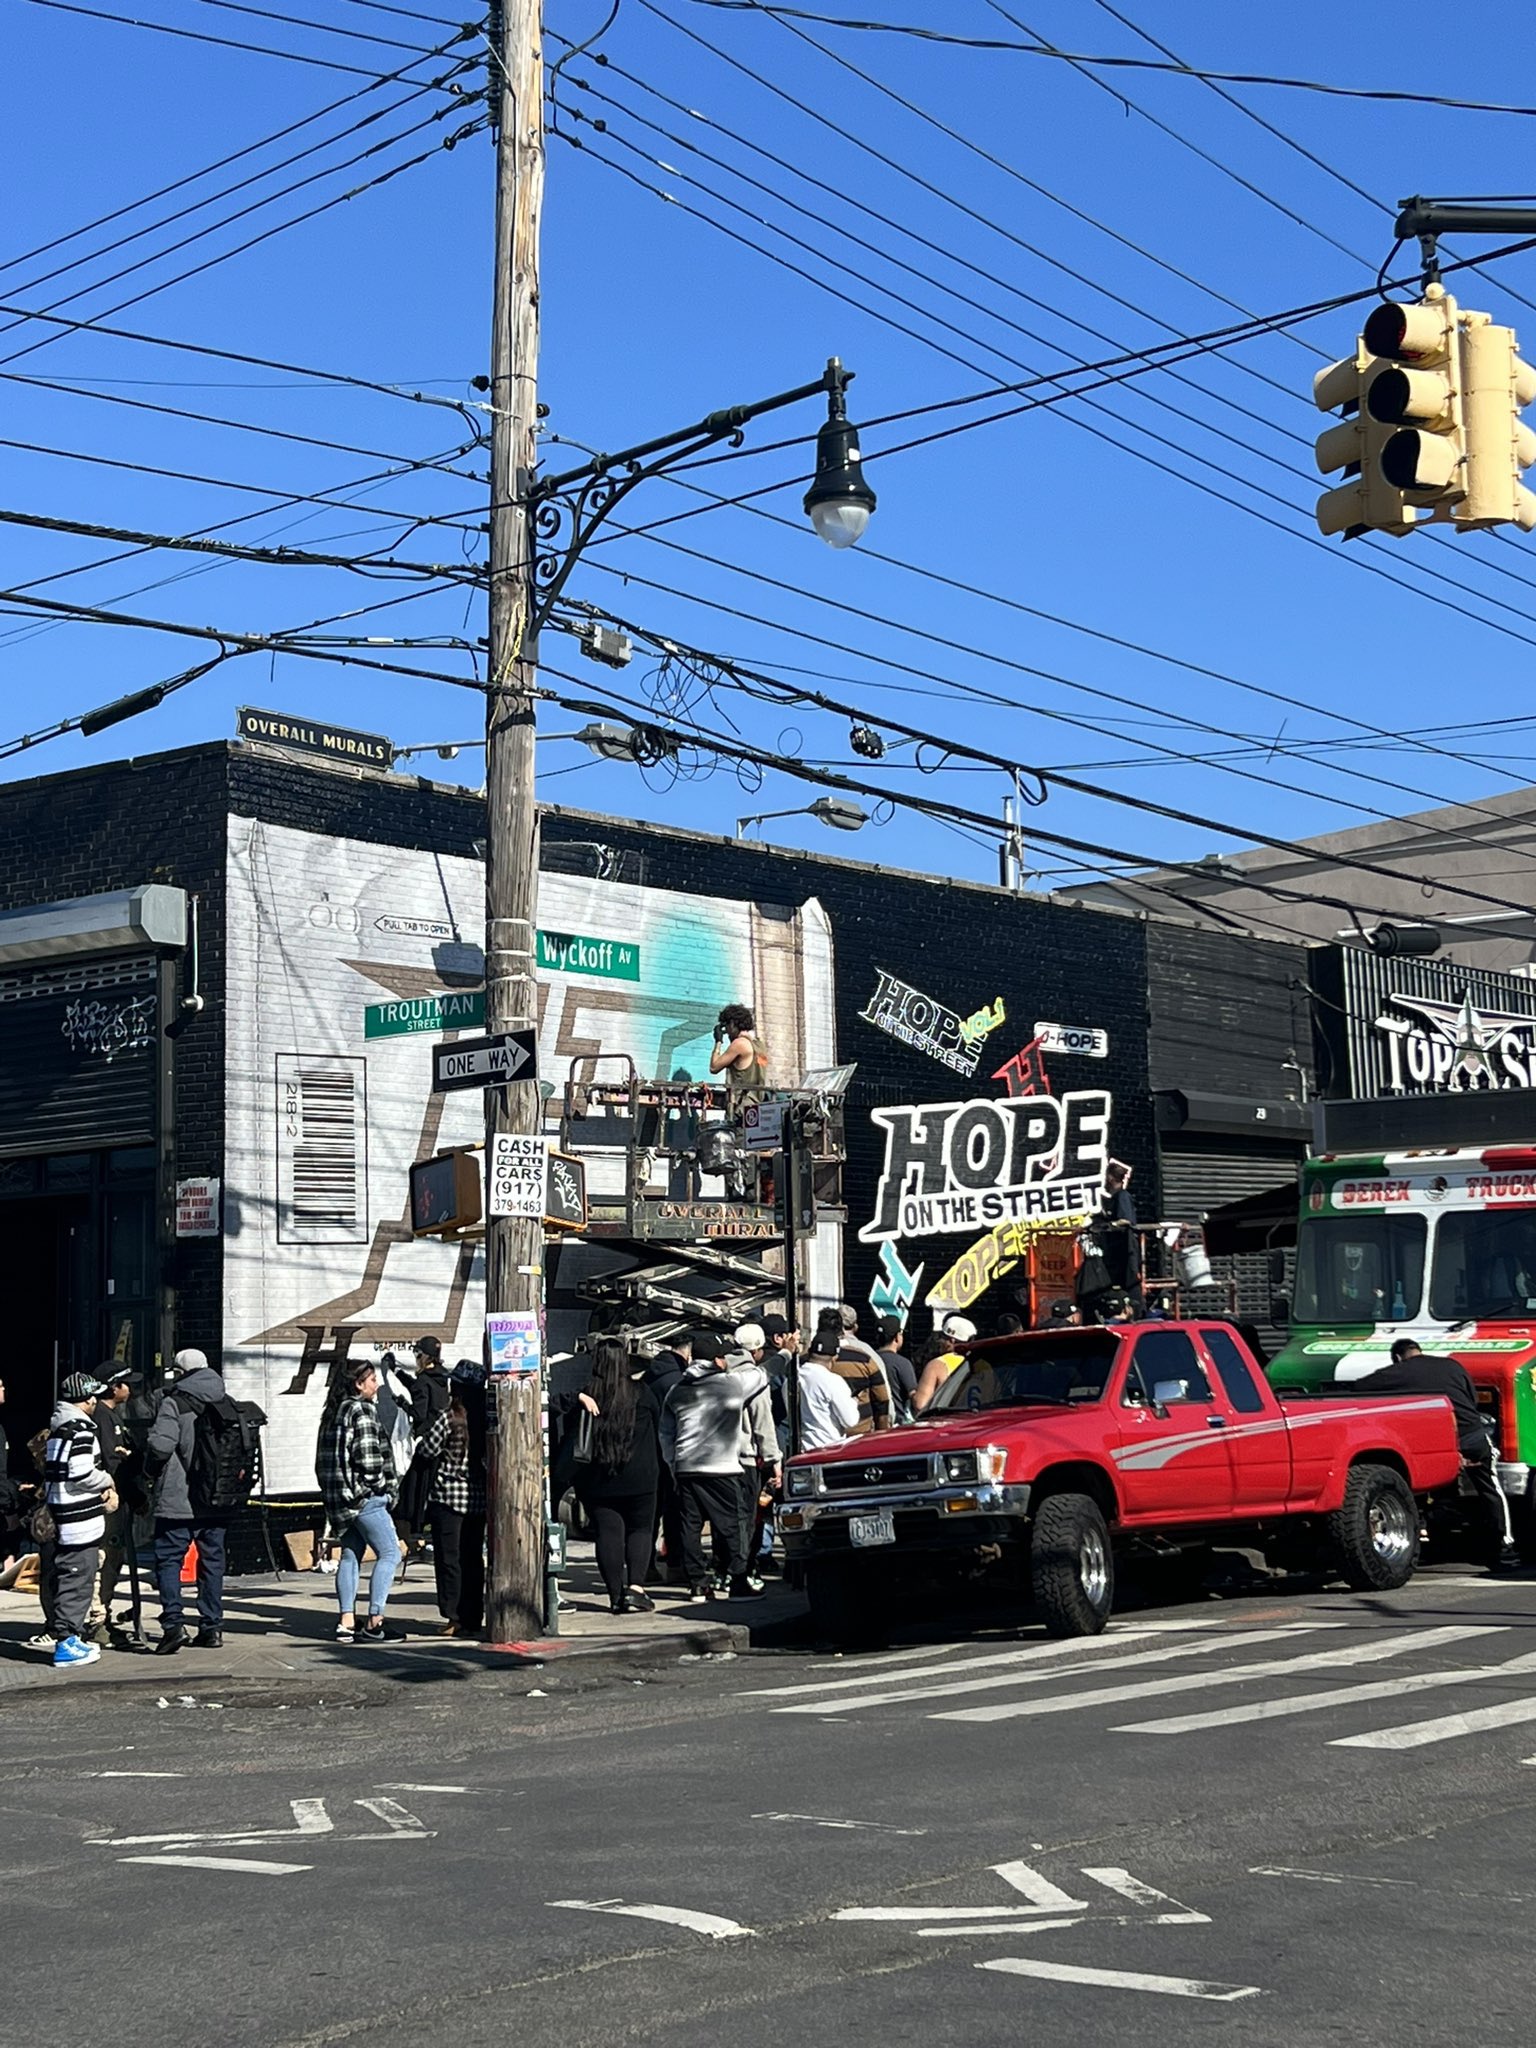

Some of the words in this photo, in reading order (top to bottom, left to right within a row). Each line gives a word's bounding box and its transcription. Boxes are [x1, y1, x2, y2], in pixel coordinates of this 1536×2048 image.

[246, 717, 318, 745] OVERALL
[322, 733, 385, 760] MURALS
[383, 919, 401, 930] PULL
[403, 921, 418, 931] TAB
[420, 923, 429, 932] TO
[430, 924, 450, 935] OPEN
[542, 935, 613, 971] Wyckoff
[618, 946, 632, 964] Av
[378, 995, 474, 1023] TROUTMAN
[407, 1018, 441, 1031] STREET
[447, 1054, 475, 1076] ONE
[489, 1047, 519, 1069] WAY
[912, 1033, 977, 1078] STREET
[286, 1082, 298, 1137] 218-2
[498, 1156, 520, 1165] FOR
[521, 1157, 542, 1166] ALL
[862, 1092, 1110, 1240] HOPE
[495, 1180, 542, 1199] (917)
[494, 1198, 542, 1213] 379-1463
[658, 1203, 768, 1220] OVERALL
[903, 1200, 934, 1231] ON
[936, 1196, 976, 1223] THE
[981, 1180, 1100, 1220] STREET
